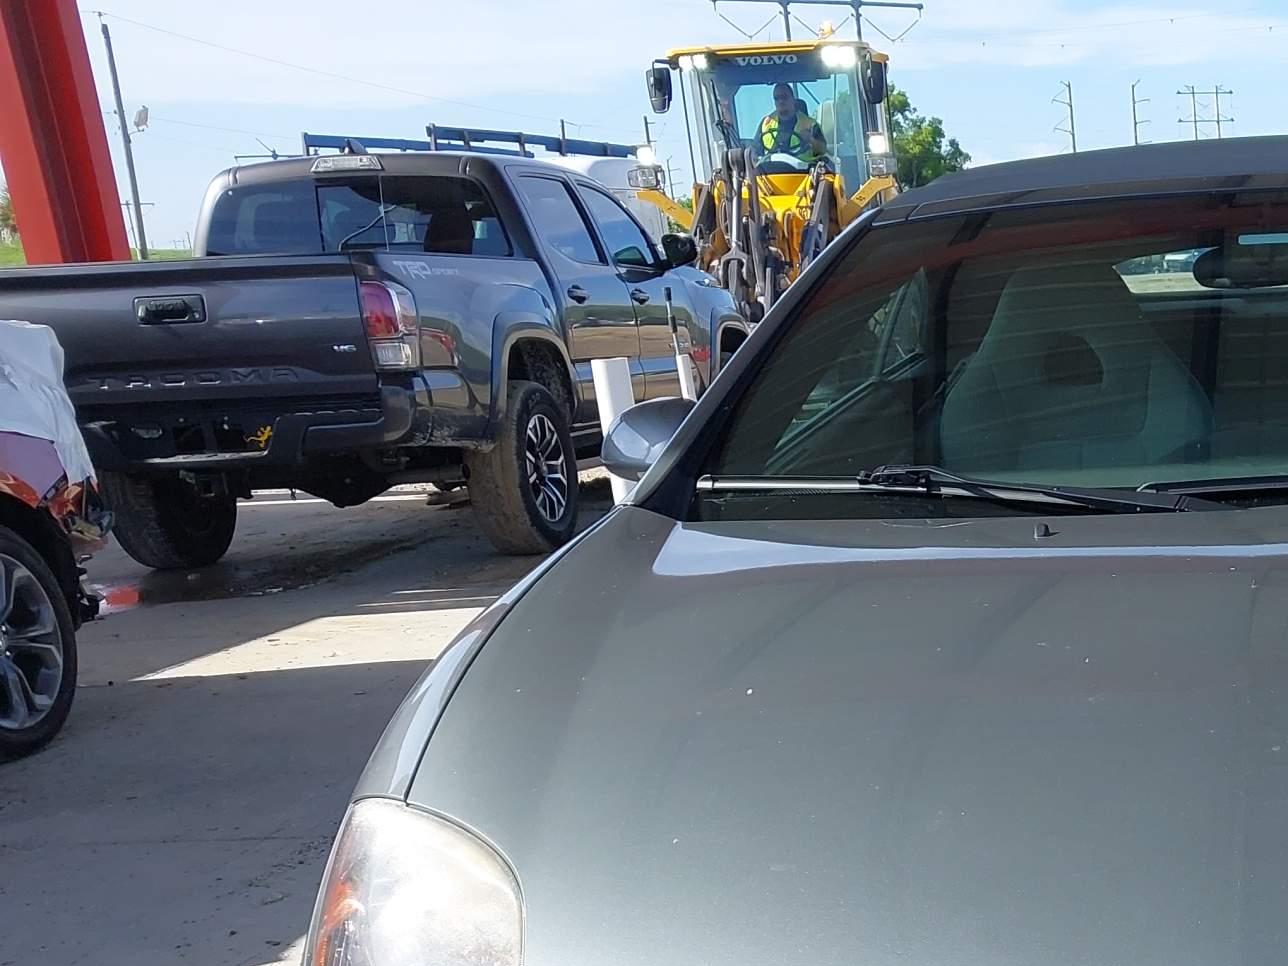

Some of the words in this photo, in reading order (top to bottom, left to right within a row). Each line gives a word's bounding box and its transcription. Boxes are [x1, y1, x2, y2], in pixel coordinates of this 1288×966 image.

[736, 54, 798, 66] VOLVO
[392, 261, 431, 279] TRD
[333, 344, 357, 352] V6
[88, 367, 299, 389] TACOMA
